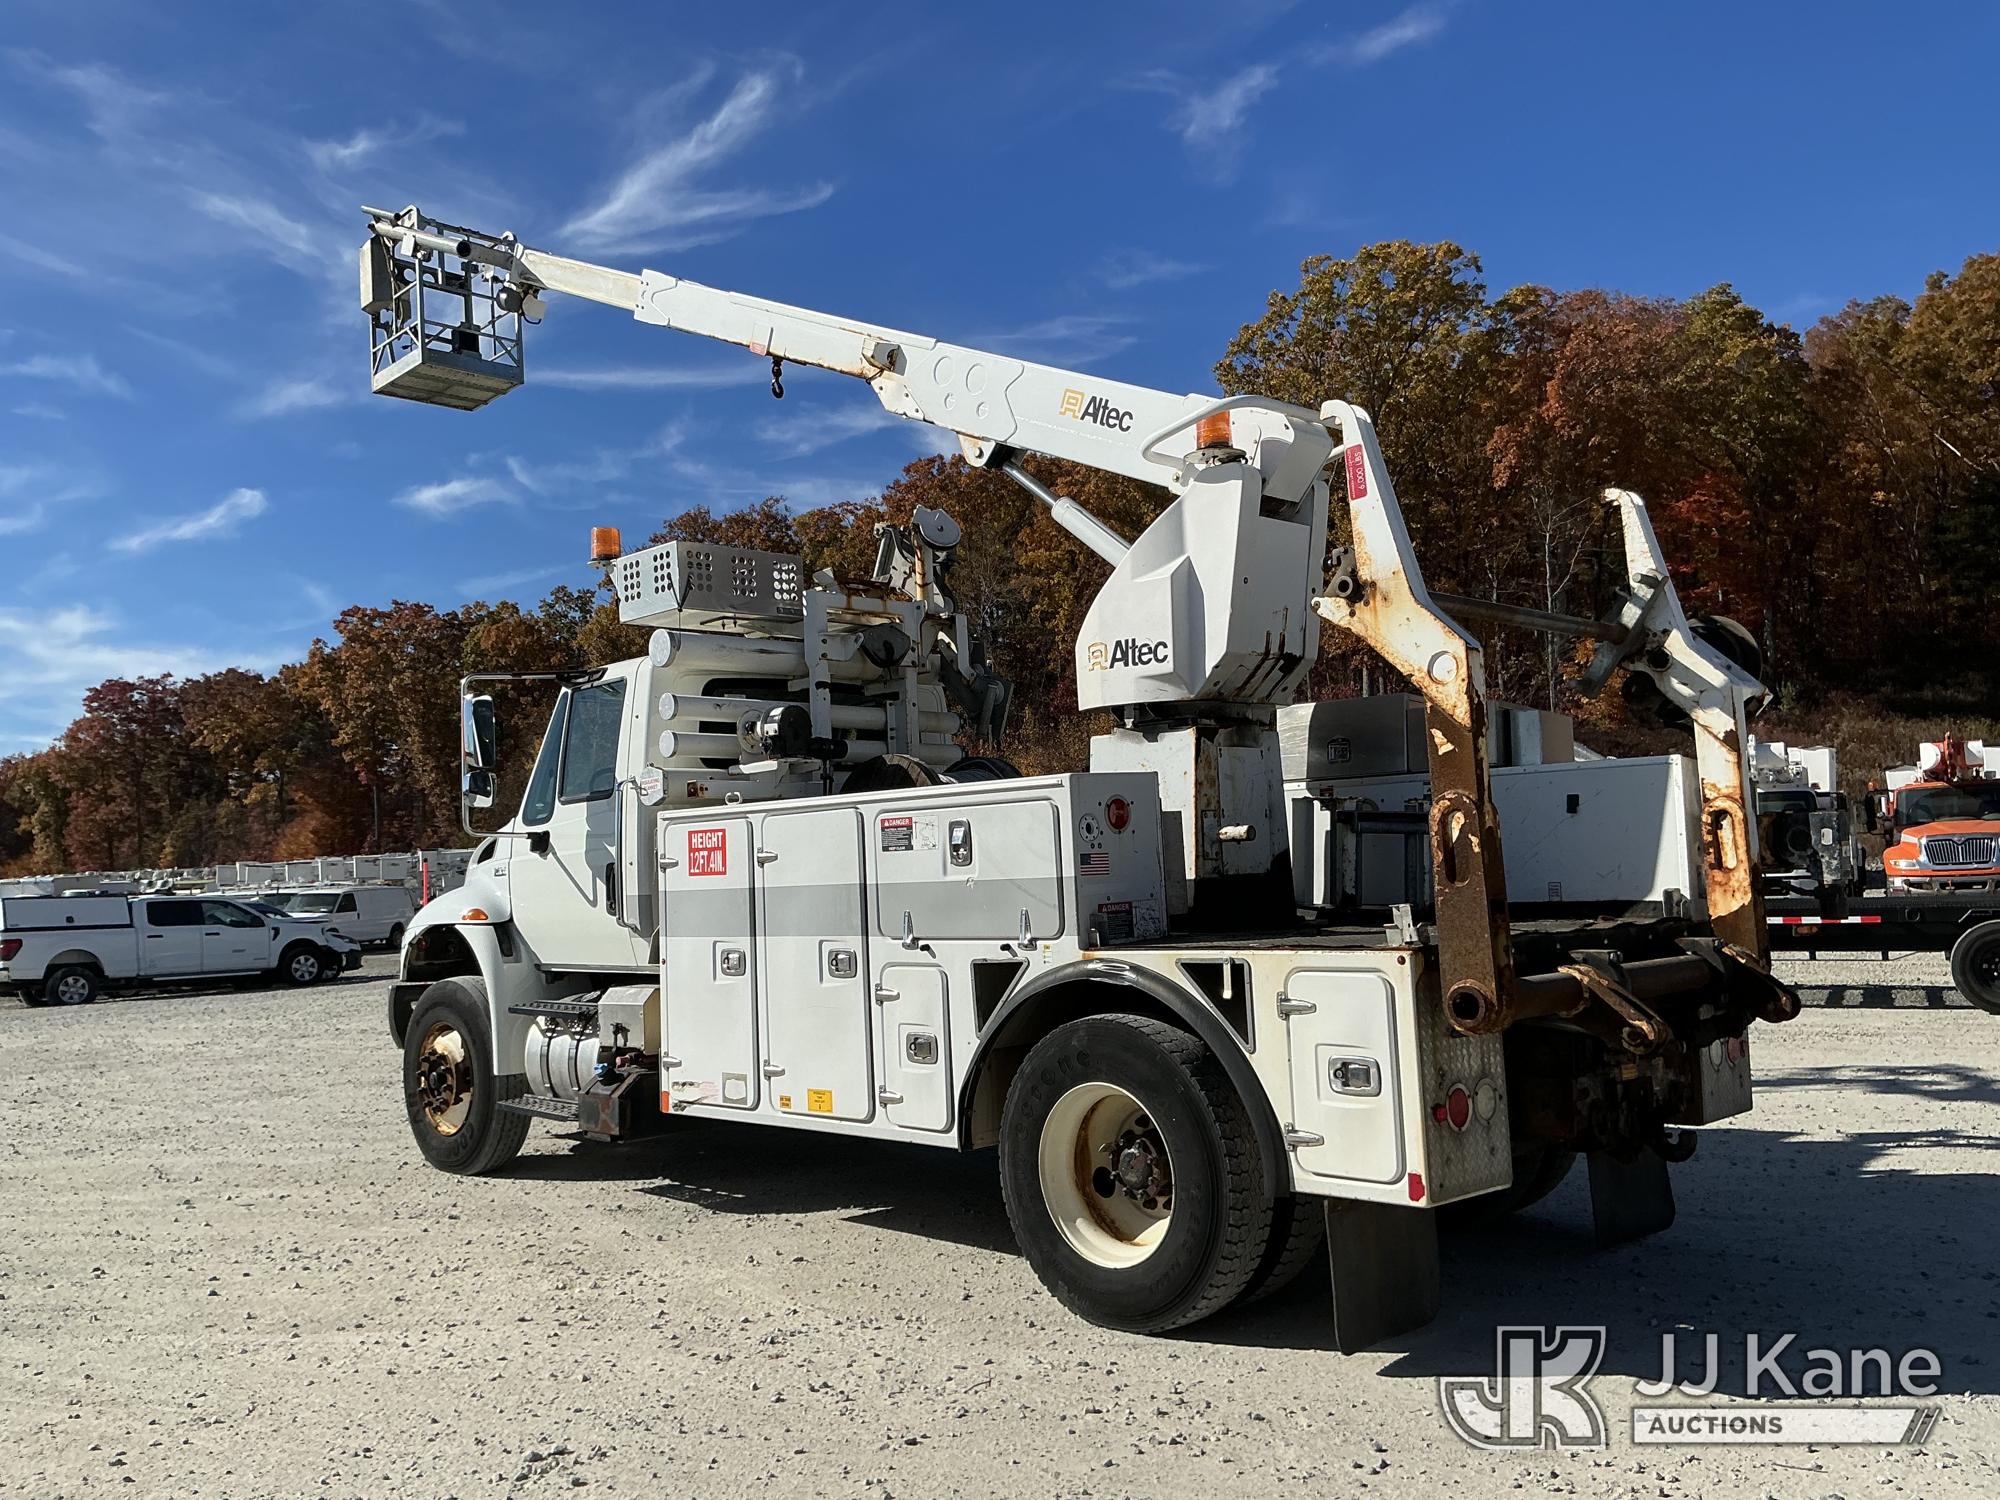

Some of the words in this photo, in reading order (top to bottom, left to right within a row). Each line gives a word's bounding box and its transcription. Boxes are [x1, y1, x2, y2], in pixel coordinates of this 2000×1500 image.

[1080, 395, 1134, 432] Altec
[1354, 451, 1363, 466] LBS
[1109, 638, 1169, 670] Altec
[890, 818, 910, 826] DANGER
[691, 831, 723, 849] HEIGHT
